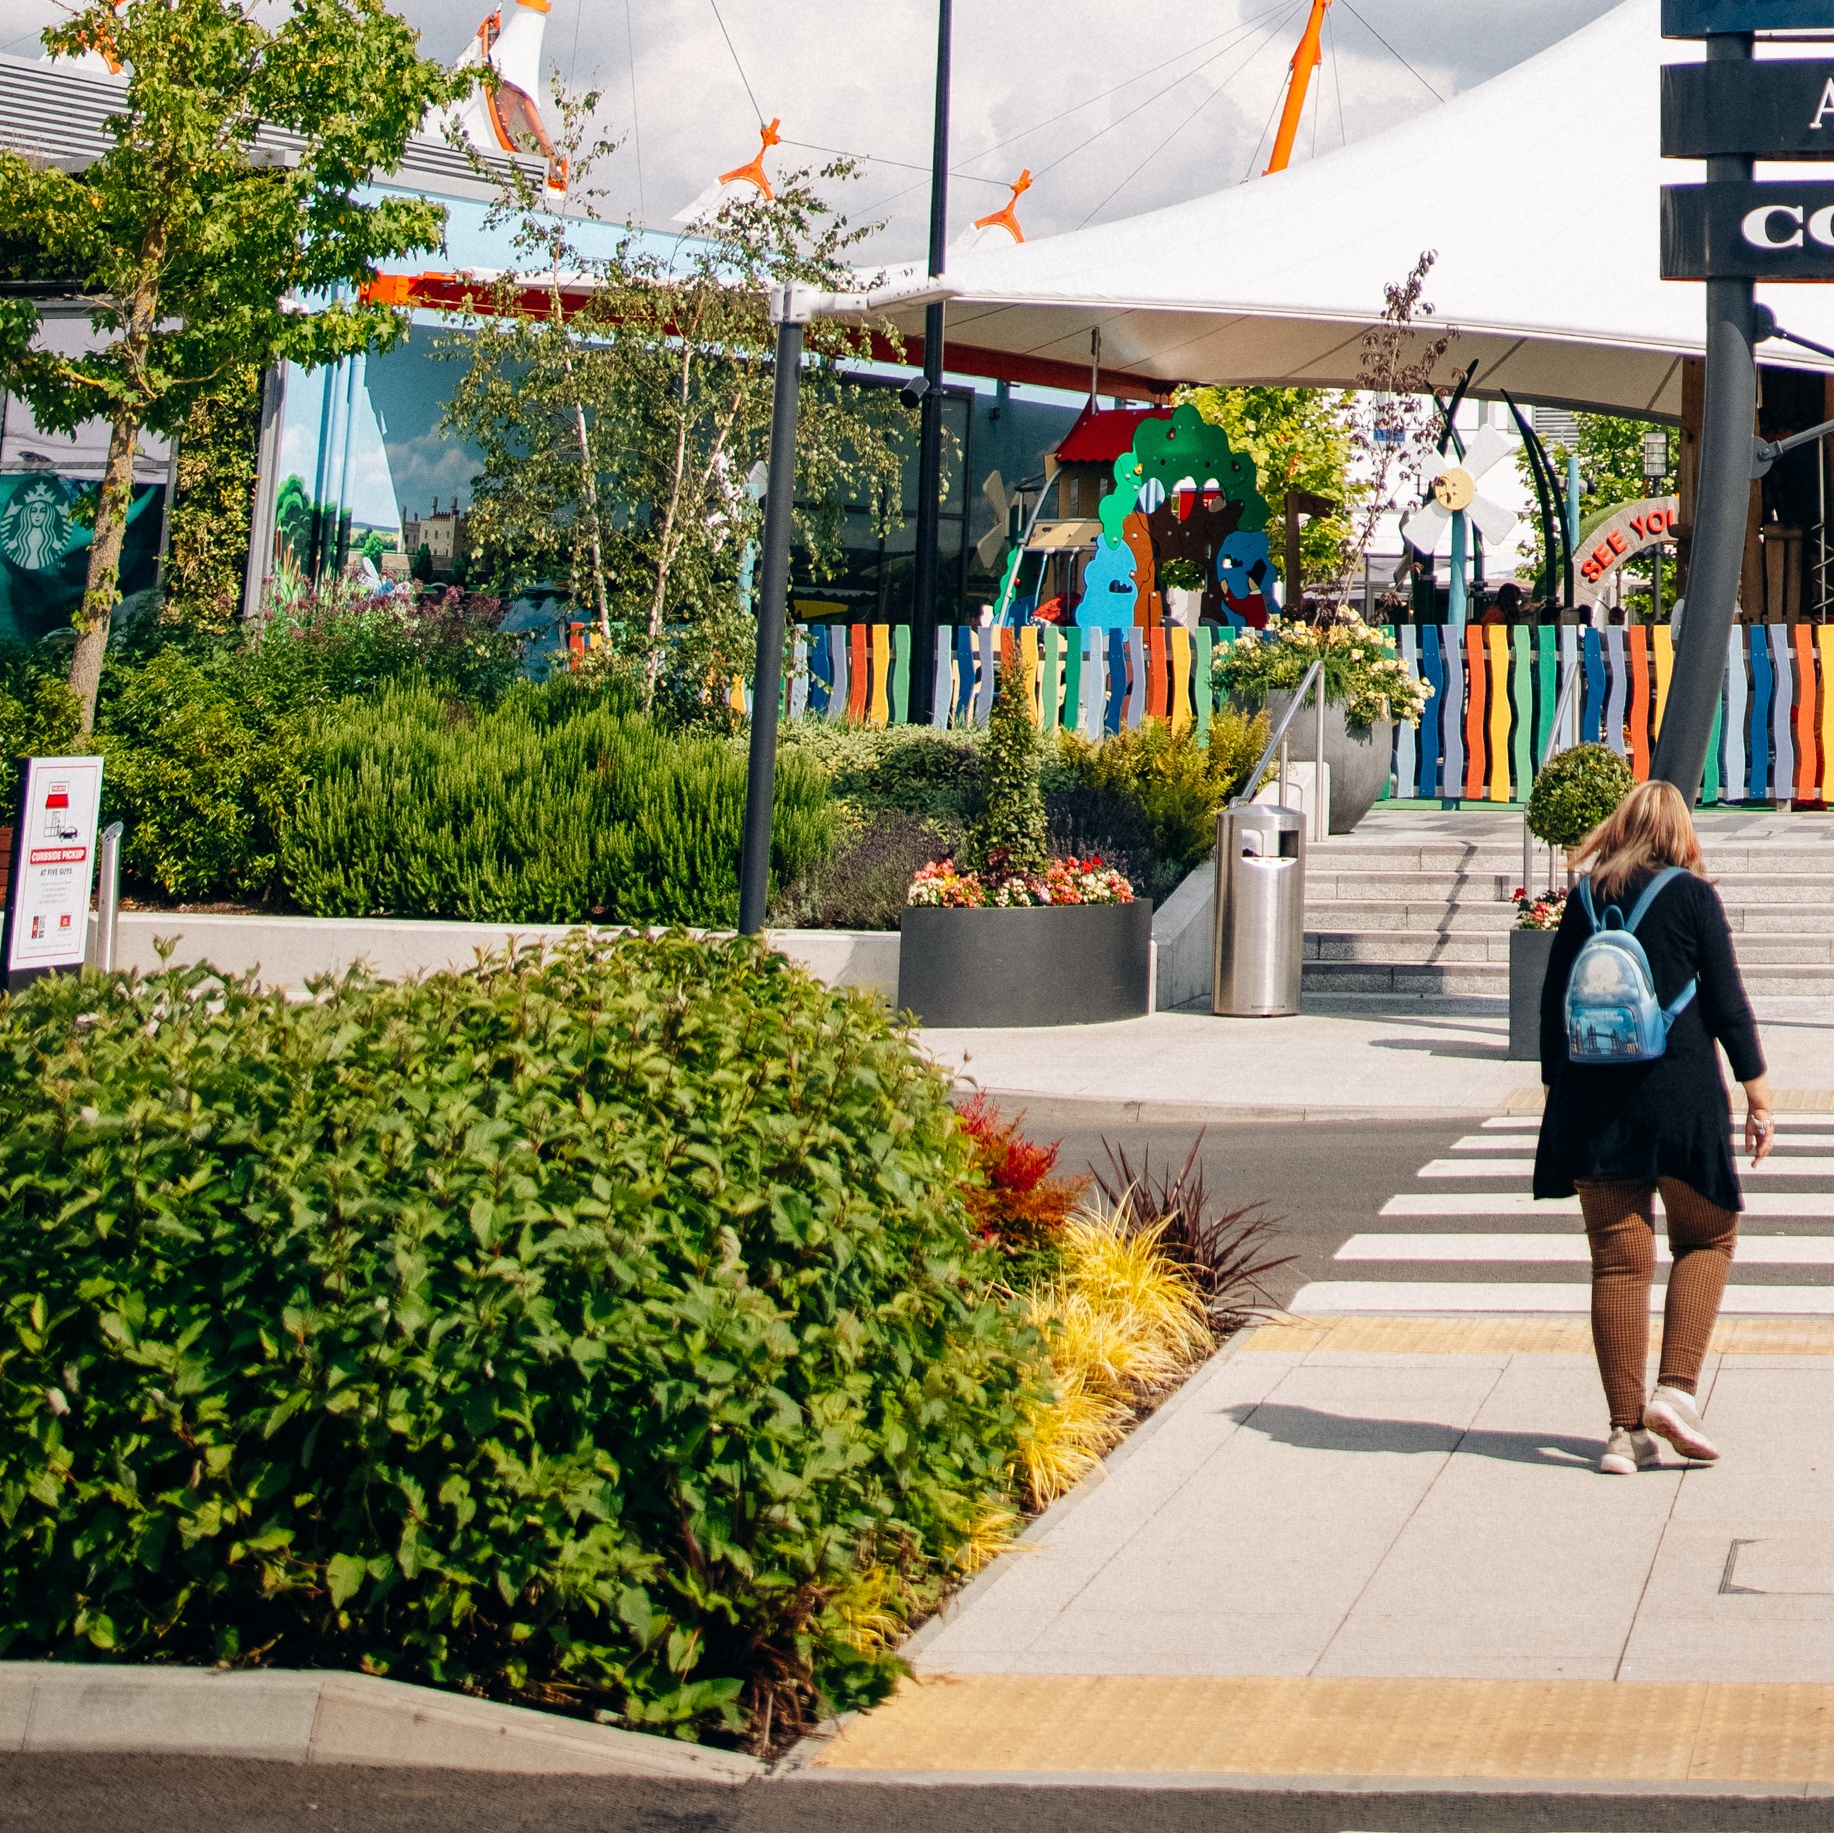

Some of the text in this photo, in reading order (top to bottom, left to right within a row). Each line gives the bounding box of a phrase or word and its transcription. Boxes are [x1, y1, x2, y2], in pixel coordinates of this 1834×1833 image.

[1581, 528, 1630, 583] SEE
[31, 849, 85, 862] CURBSIDE PICKUP
[47, 868, 58, 876] FIVE
[59, 867, 73, 875] GUYS
